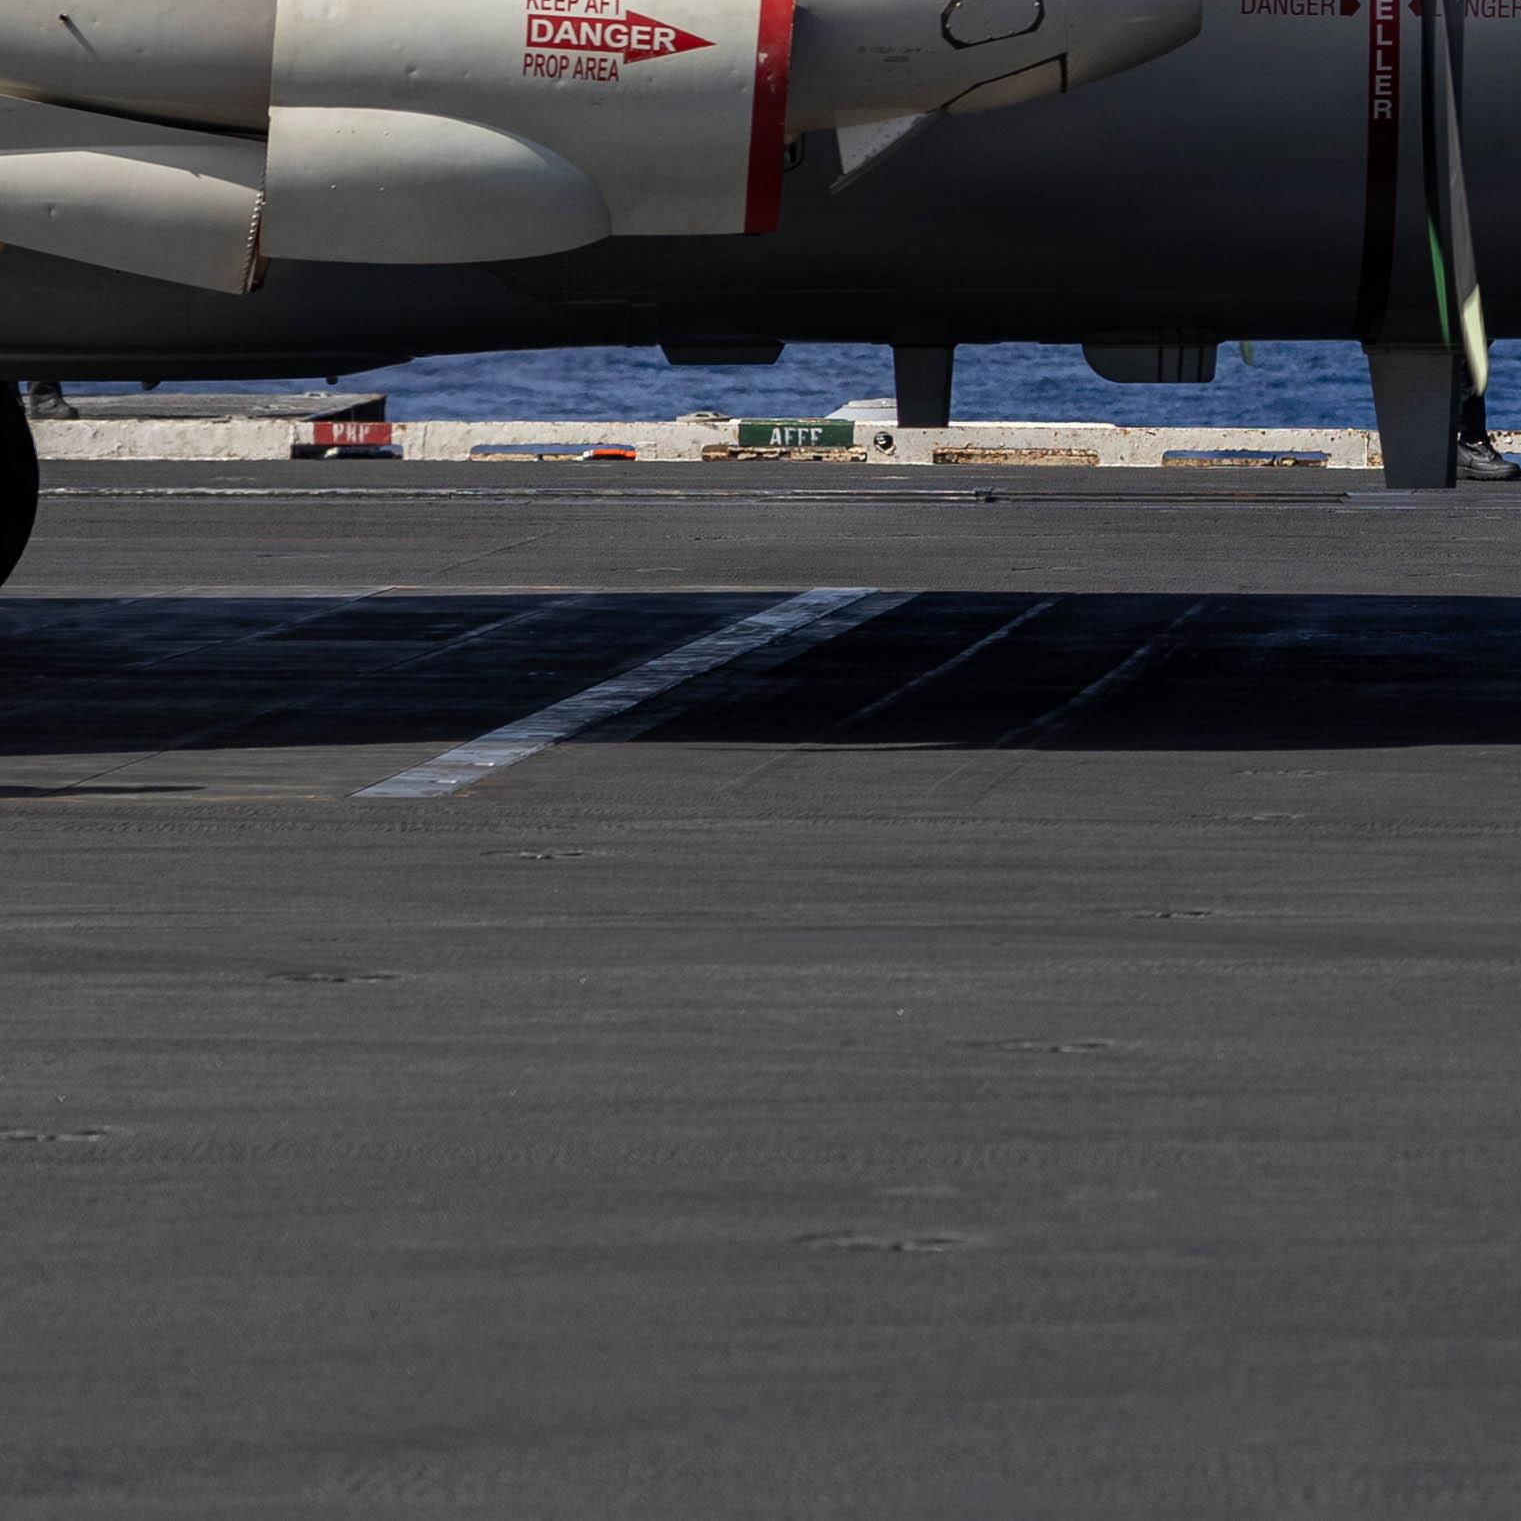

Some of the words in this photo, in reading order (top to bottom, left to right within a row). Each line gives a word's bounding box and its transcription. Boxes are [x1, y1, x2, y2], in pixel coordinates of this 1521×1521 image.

[530, 18, 677, 52] DANGER
[523, 53, 570, 79] PROP
[572, 56, 620, 82] AREA
[769, 426, 824, 446] AFFF
